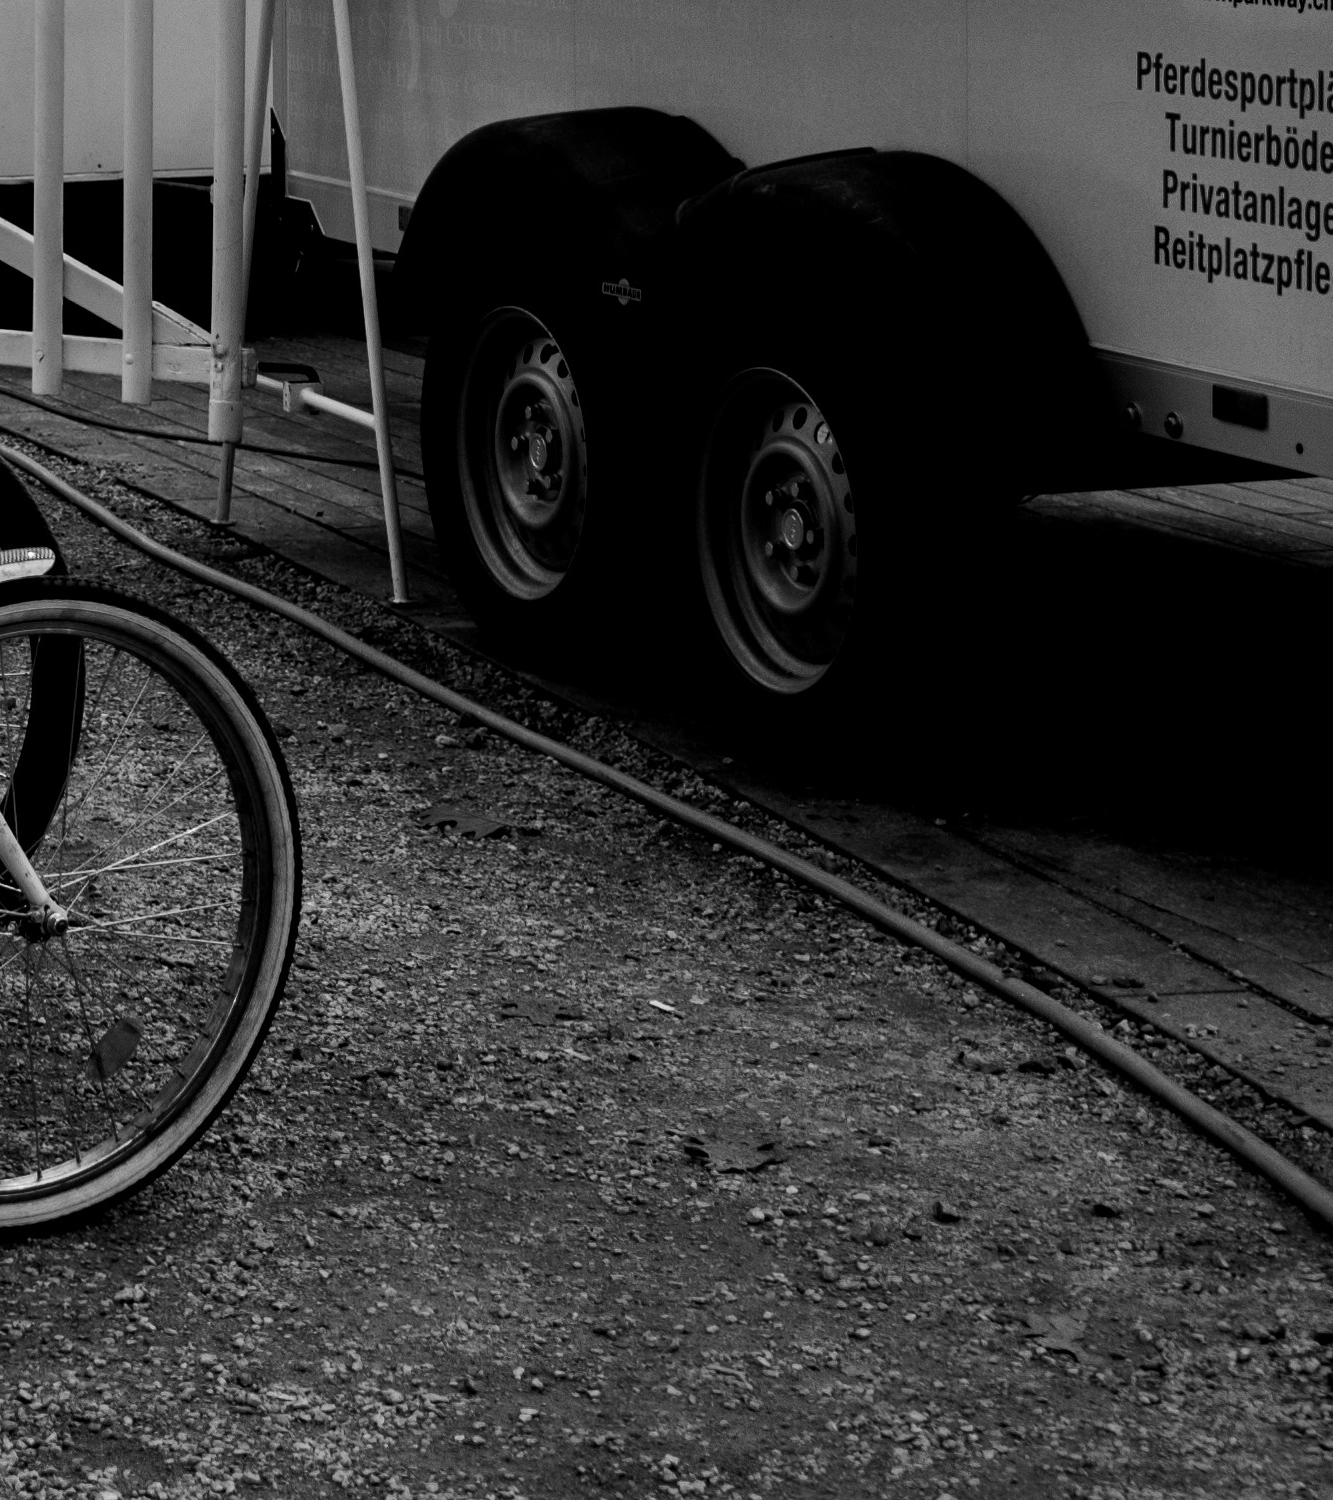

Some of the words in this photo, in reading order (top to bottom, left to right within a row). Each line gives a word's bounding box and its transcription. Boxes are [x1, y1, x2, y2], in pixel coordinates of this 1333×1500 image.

[1165, 111, 1333, 174] Turnierböde
[1162, 168, 1333, 242] Privatanlage
[603, 283, 641, 300] HUMBAUR
[1154, 225, 1332, 296] Reitplatzpfle
